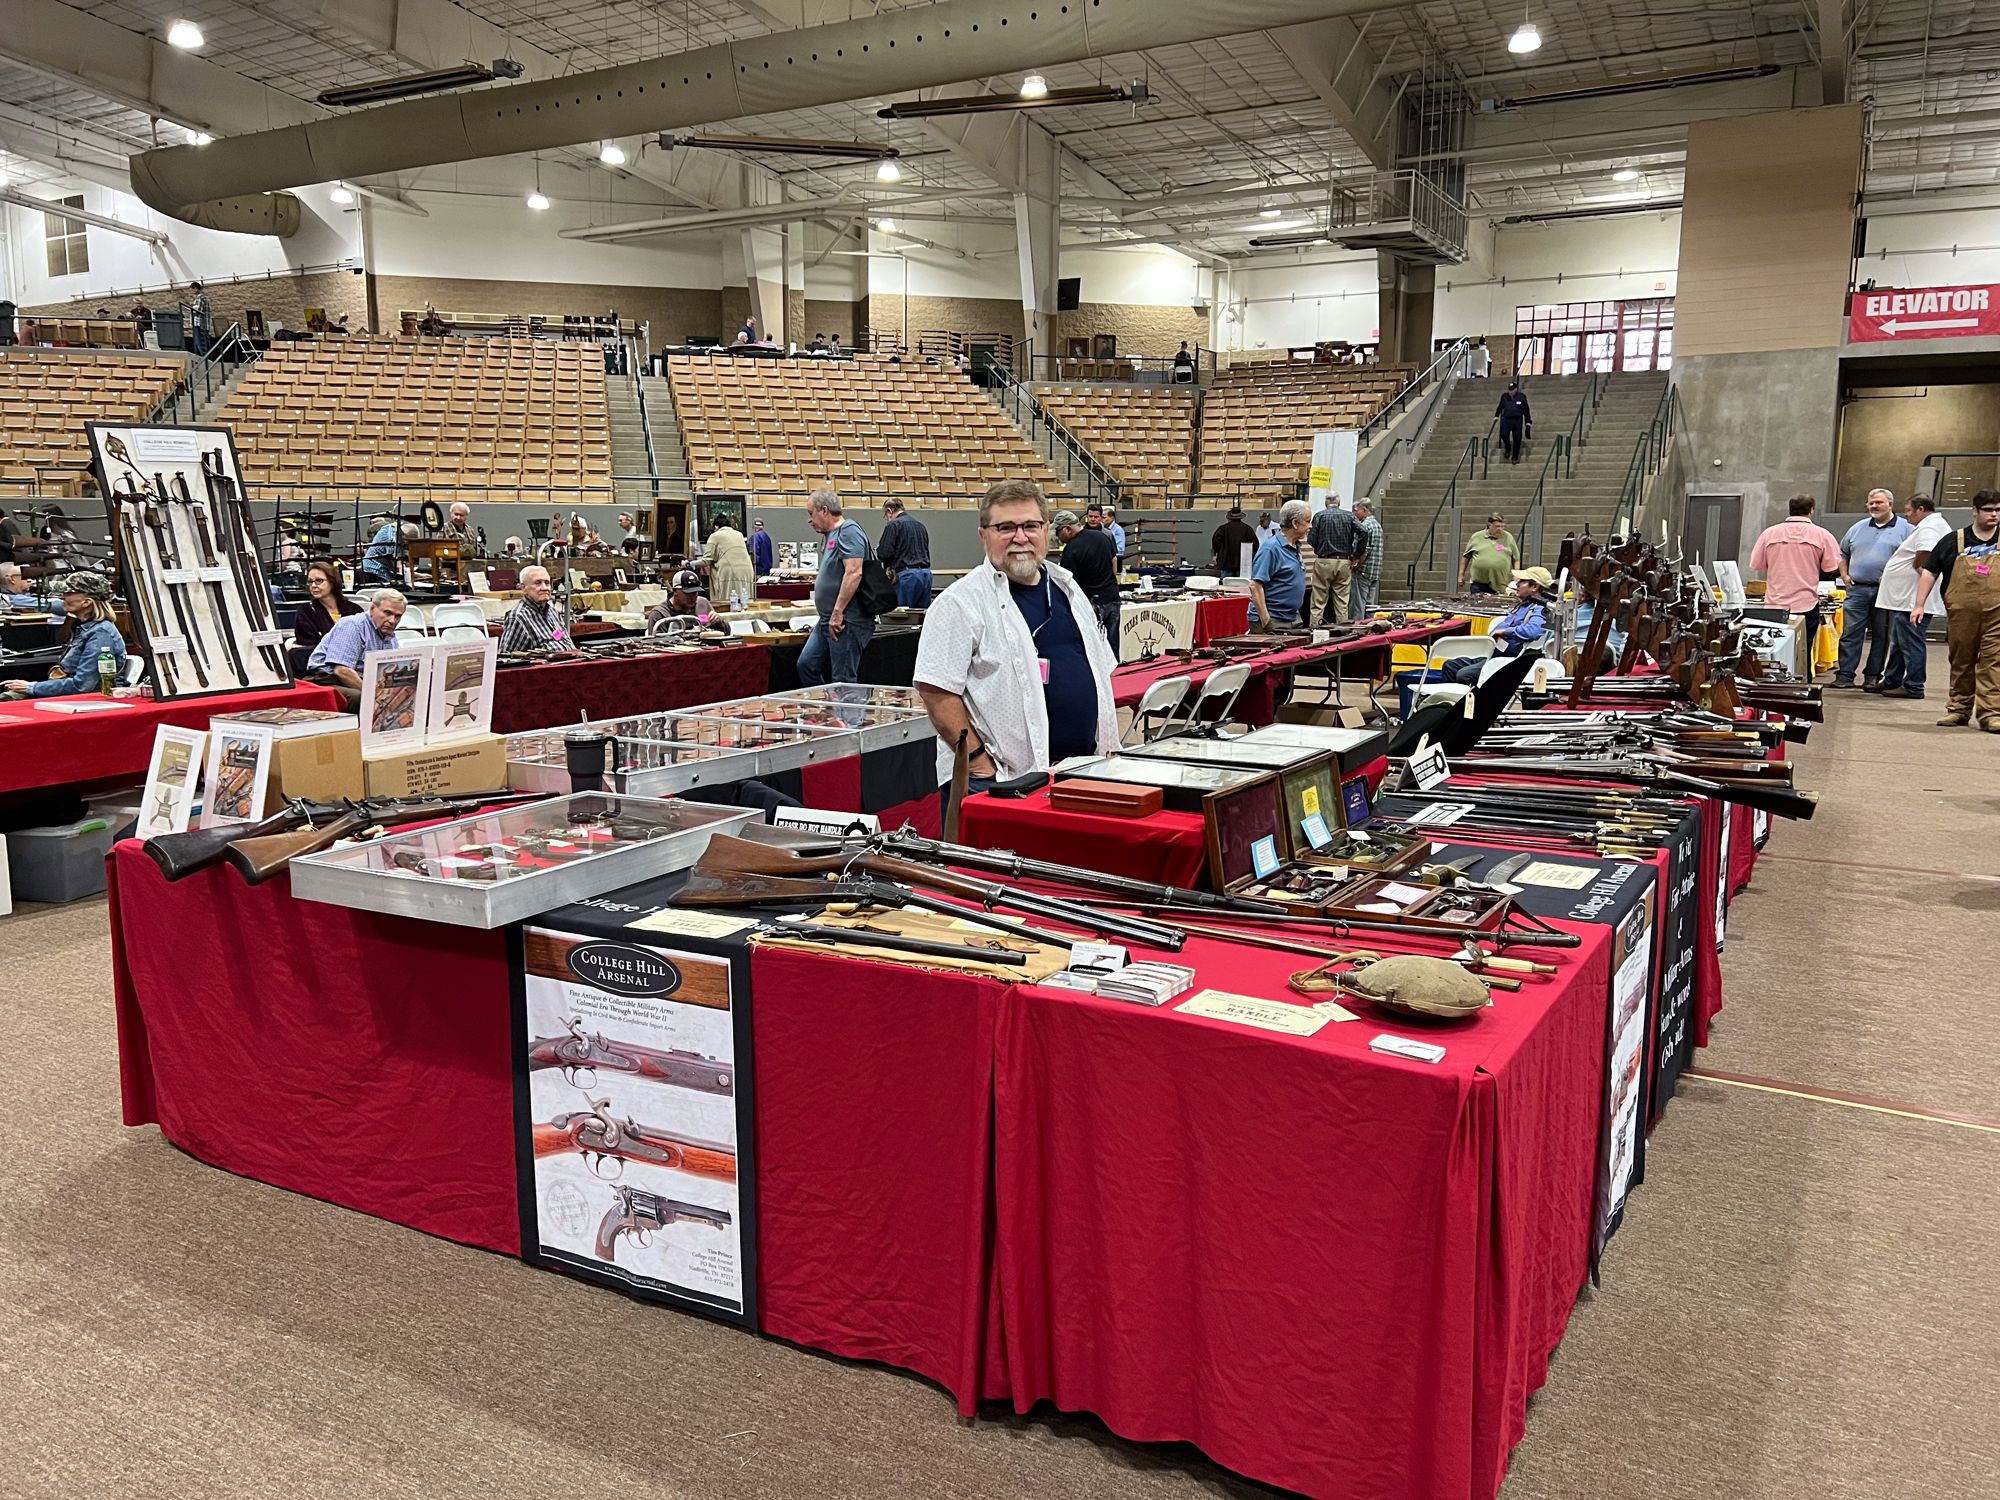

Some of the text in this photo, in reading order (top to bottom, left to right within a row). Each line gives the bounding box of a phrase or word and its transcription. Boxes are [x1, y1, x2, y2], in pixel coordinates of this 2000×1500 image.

[1865, 289, 1989, 317] ELEVATOR
[1124, 614, 1138, 636] TEXAS
[1140, 610, 1150, 622] GUN
[778, 820, 842, 835] PLEASE DO NOT HANDLE
[572, 898, 640, 912] ollege
[1568, 896, 1615, 919] College
[581, 950, 666, 976] COLLEGE HILL
[598, 968, 650, 987] ARSENAL
[576, 999, 598, 1008] Colonial
[610, 1005, 631, 1016] Through
[581, 992, 602, 1002] Antique
[609, 998, 636, 1007] Collectible
[638, 1002, 659, 1013] Military
[1226, 1008, 1281, 1021] HANDLE
